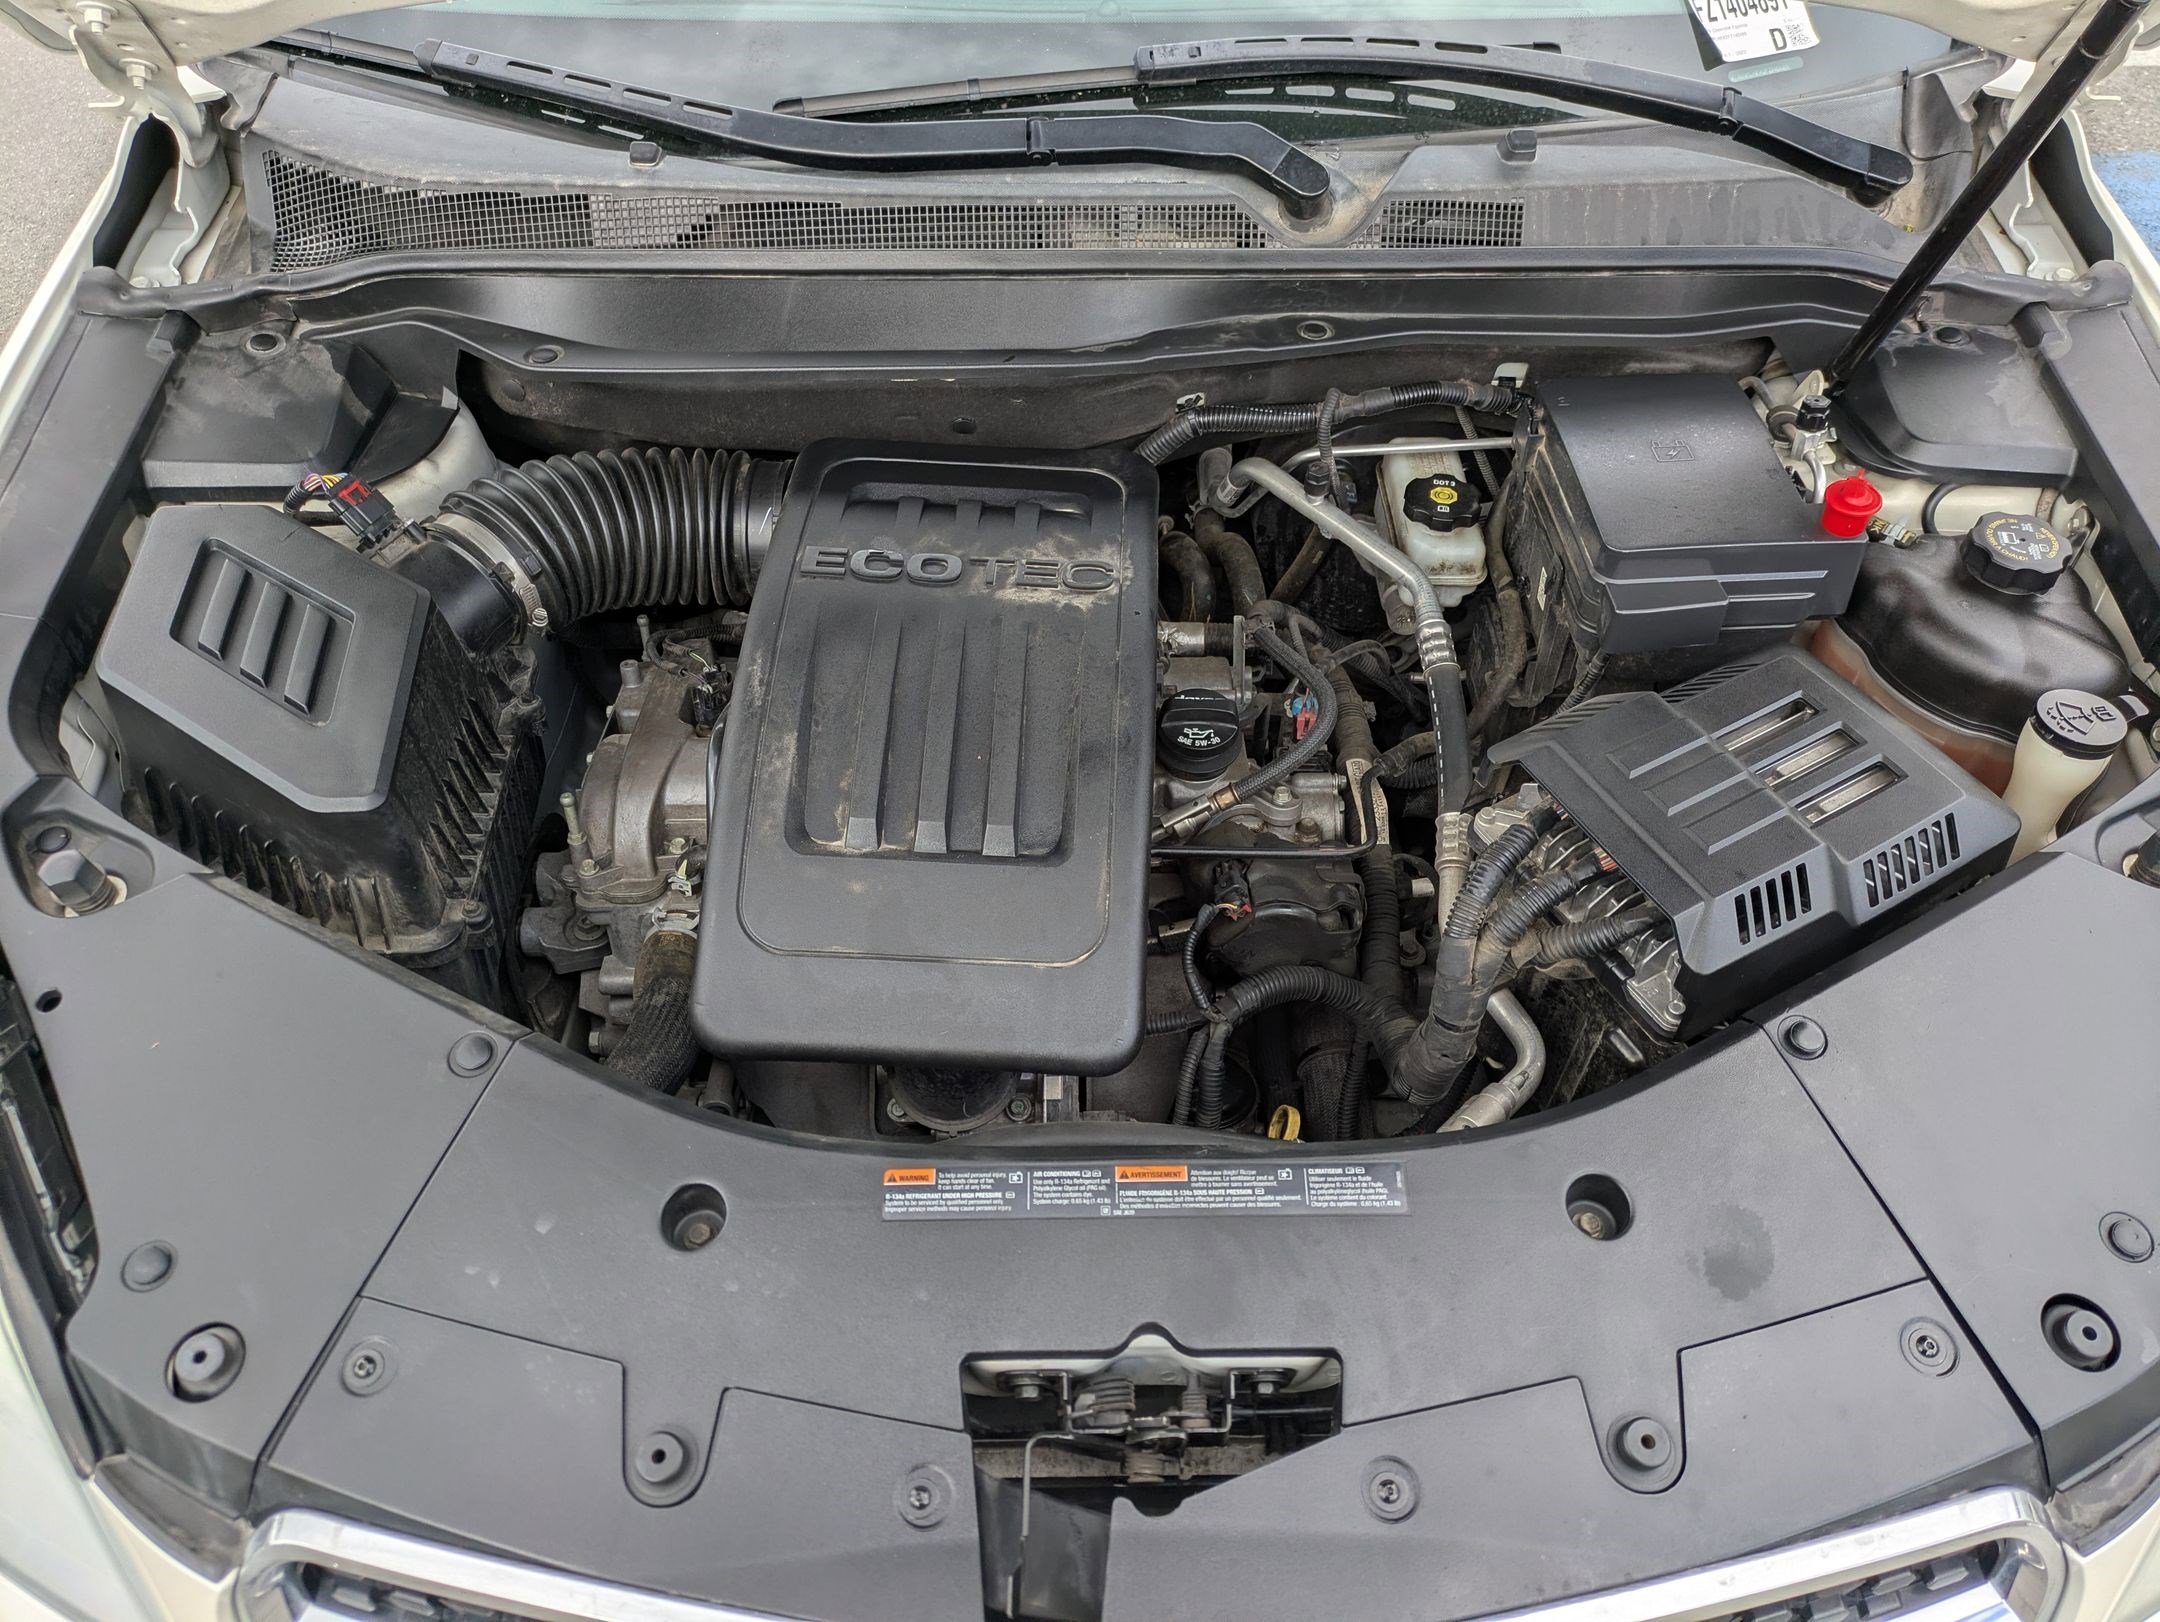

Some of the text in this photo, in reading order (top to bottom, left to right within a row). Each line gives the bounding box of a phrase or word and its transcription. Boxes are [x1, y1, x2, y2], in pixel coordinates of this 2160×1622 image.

[1769, 28, 1788, 51] D
[799, 545, 1117, 593] ECOTEC
[1177, 736, 1221, 747] SAE 5W-30
